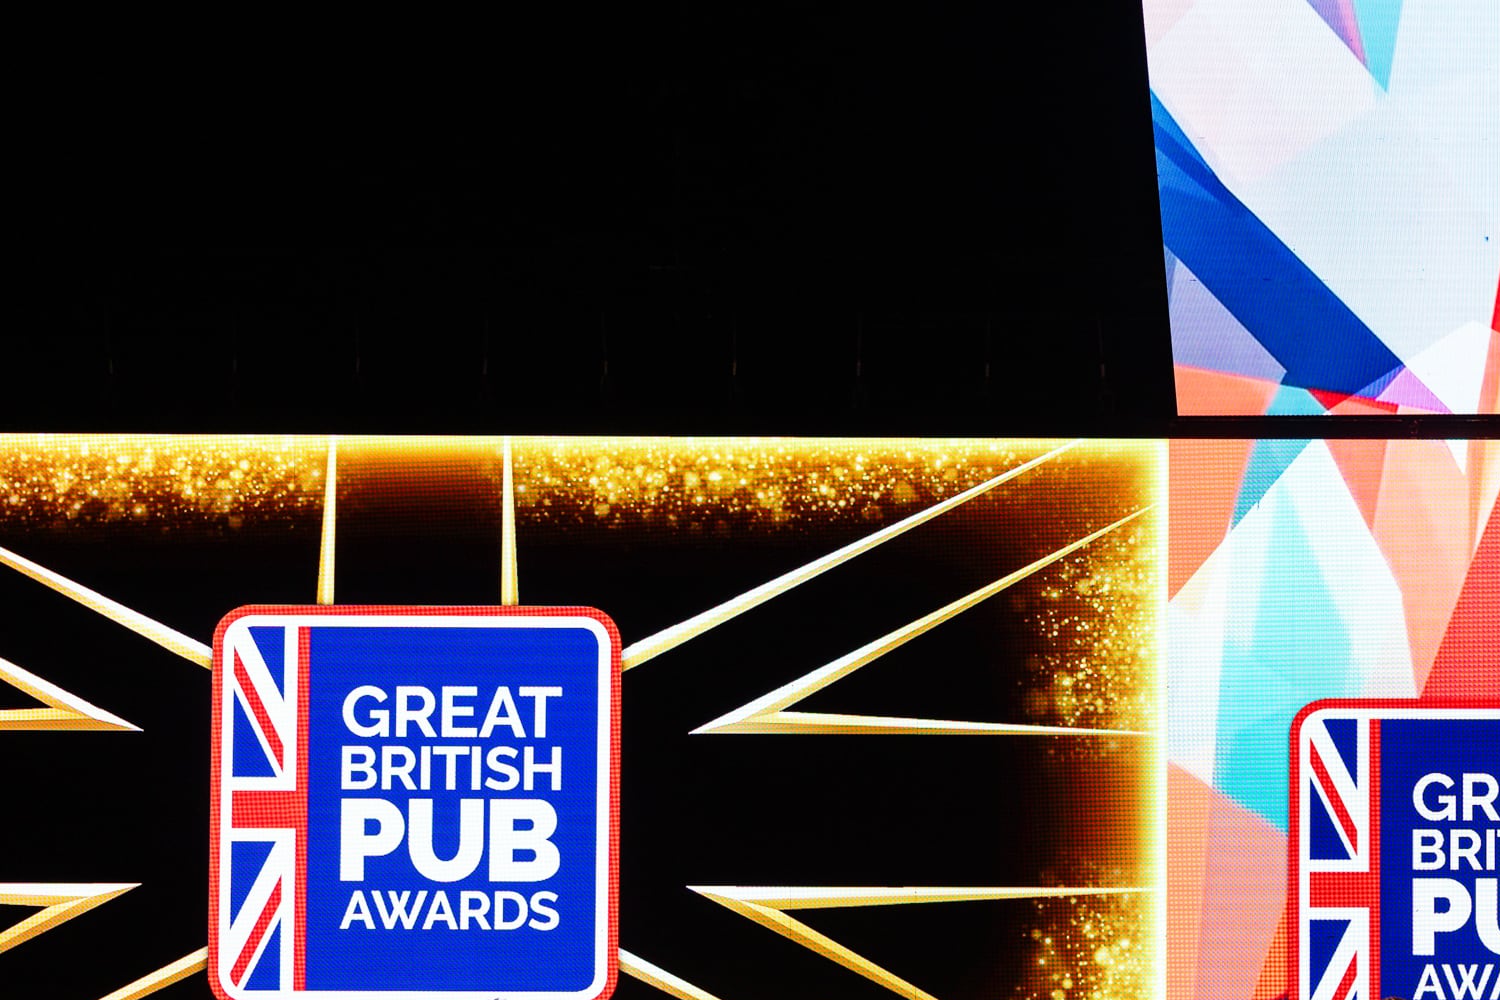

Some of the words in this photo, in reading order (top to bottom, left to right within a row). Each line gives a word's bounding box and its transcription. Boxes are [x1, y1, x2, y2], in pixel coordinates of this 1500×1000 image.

[342, 685, 563, 738] GREAT
[341, 746, 562, 791] BRITISH
[339, 798, 561, 883] PUB
[339, 890, 560, 931] AWARDS
